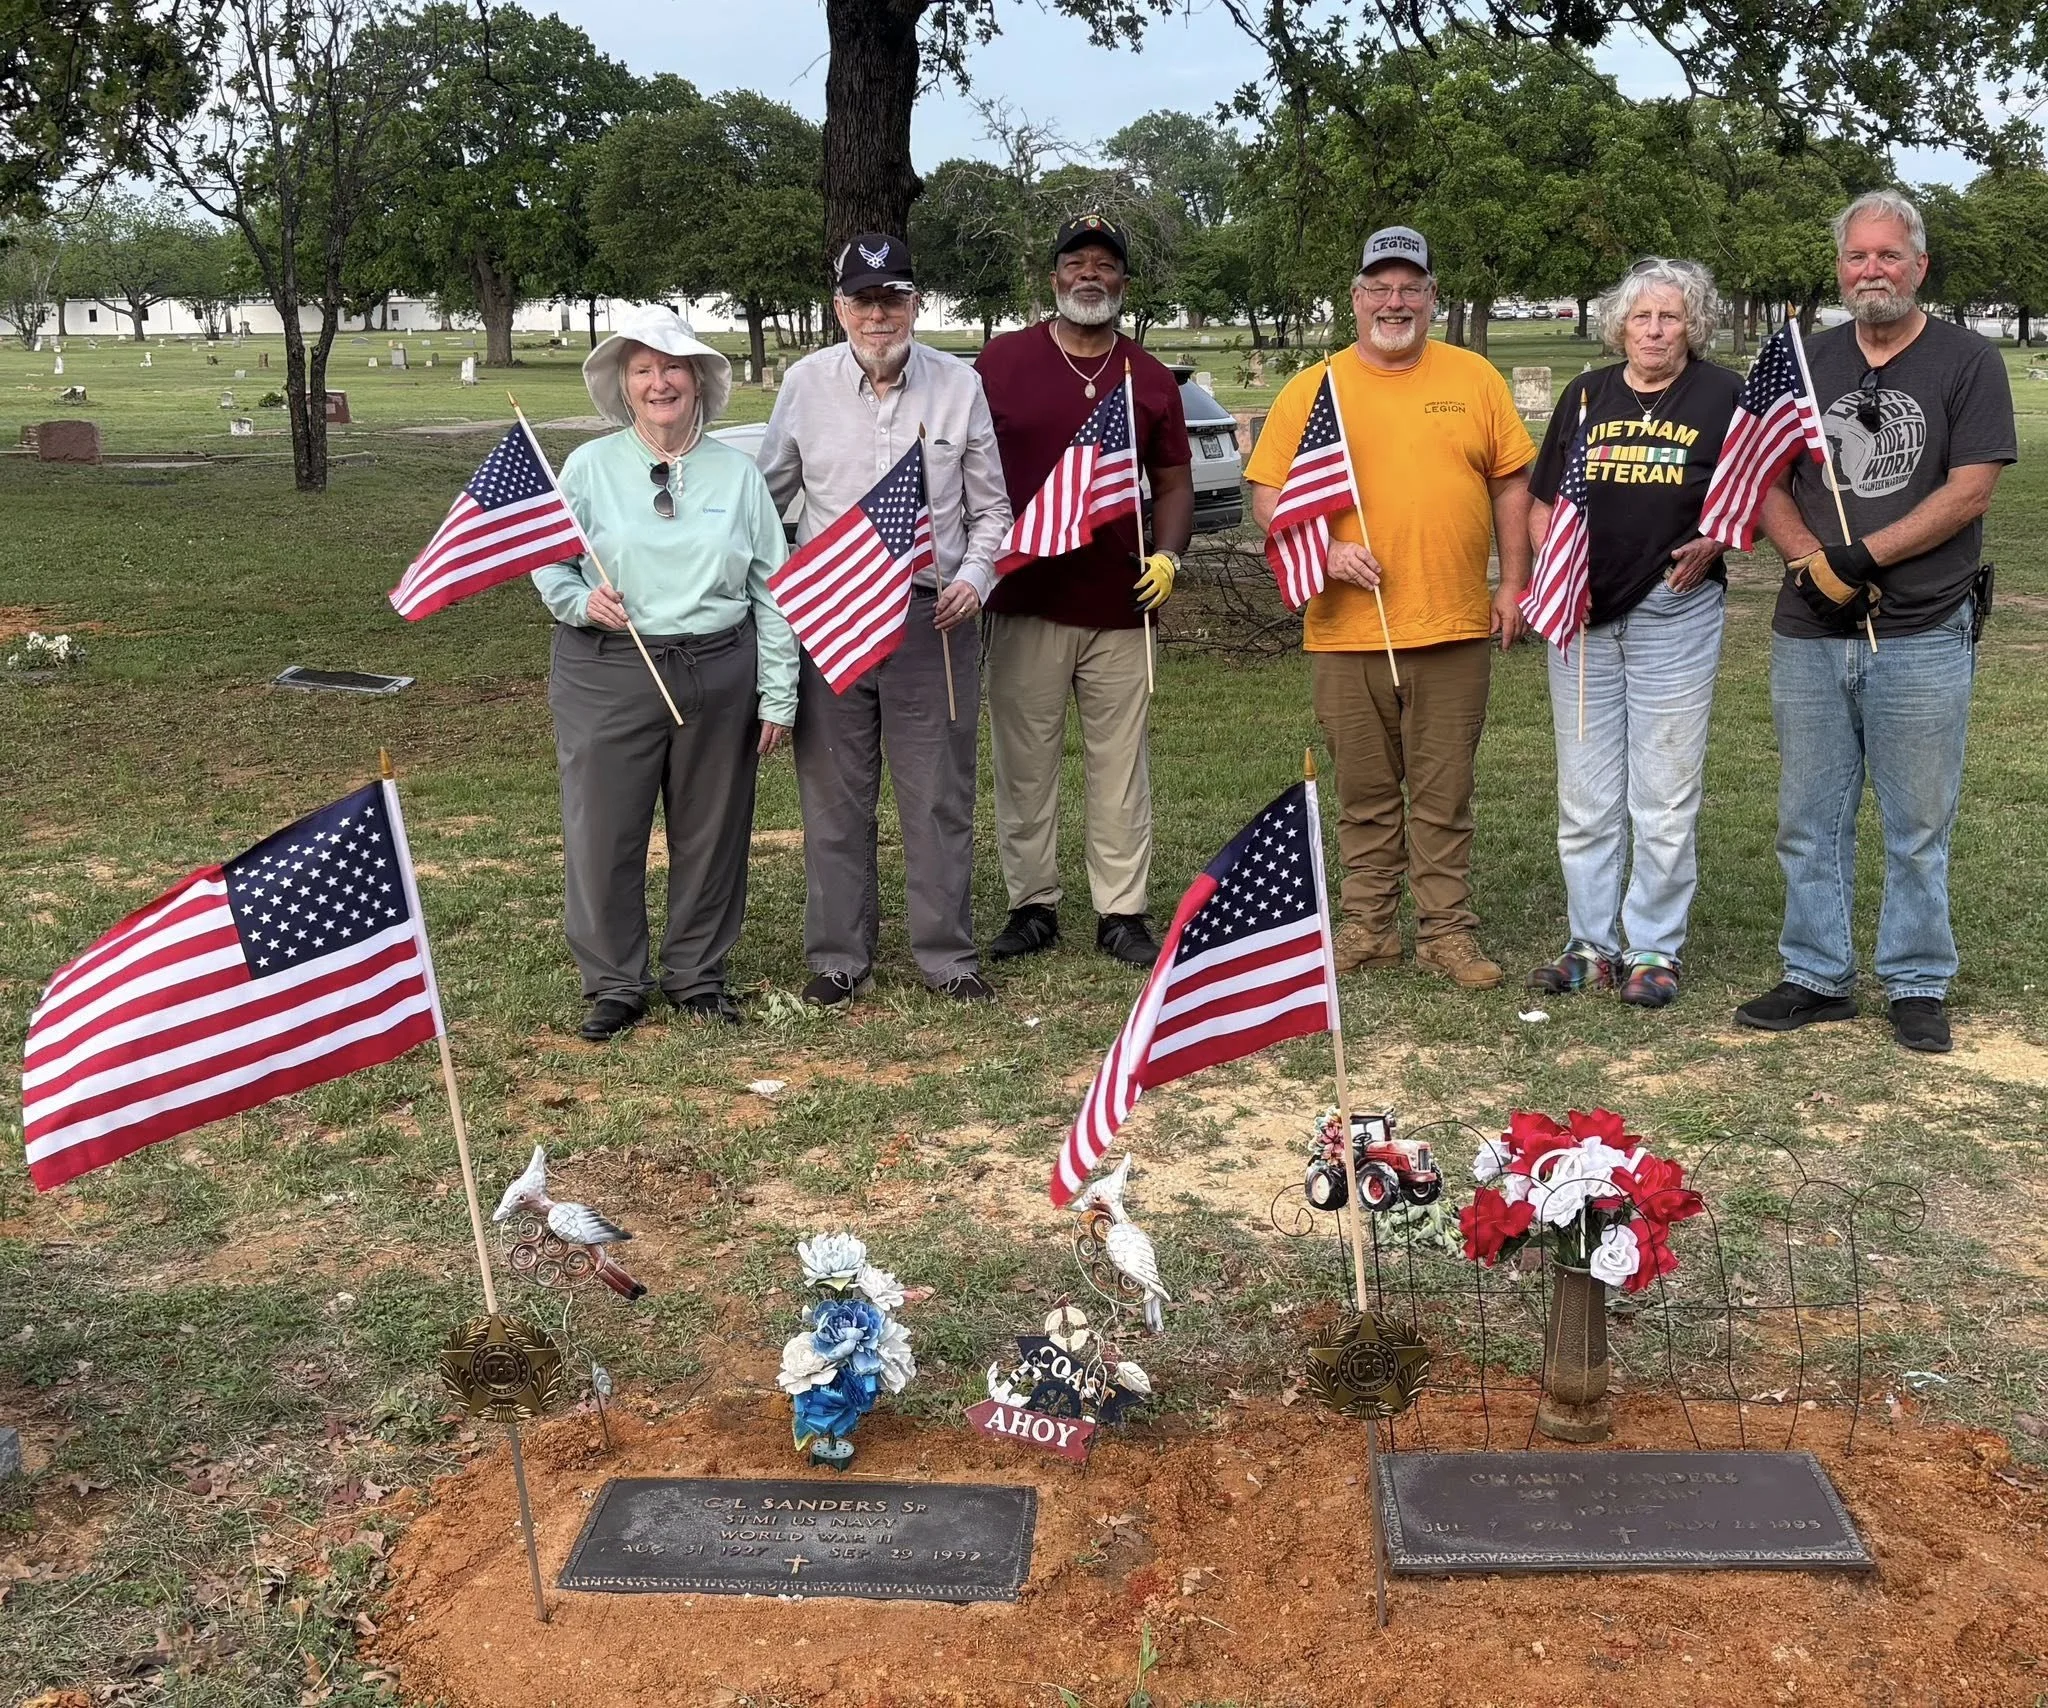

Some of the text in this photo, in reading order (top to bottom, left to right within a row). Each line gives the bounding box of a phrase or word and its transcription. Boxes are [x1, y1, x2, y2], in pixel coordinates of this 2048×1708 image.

[1372, 240, 1420, 254] LEGION
[1424, 405, 1466, 414] LEGION
[1586, 419, 1700, 447] VIETNAM
[1873, 421, 1925, 456] RIDE TO
[1585, 461, 1684, 485] ETERAN
[1862, 449, 1921, 481] WORK
[984, 1407, 1078, 1448] AHOY
[760, 1498, 888, 1513] SANDERS
[791, 1517, 817, 1528] US
[830, 1518, 897, 1529] NAVY
[1421, 1522, 1467, 1533] JUL
[720, 1530, 893, 1545] WORLD WAR II
[622, 1544, 666, 1555] AUG
[829, 1547, 871, 1559] SEP
[890, 1549, 914, 1561] 29
